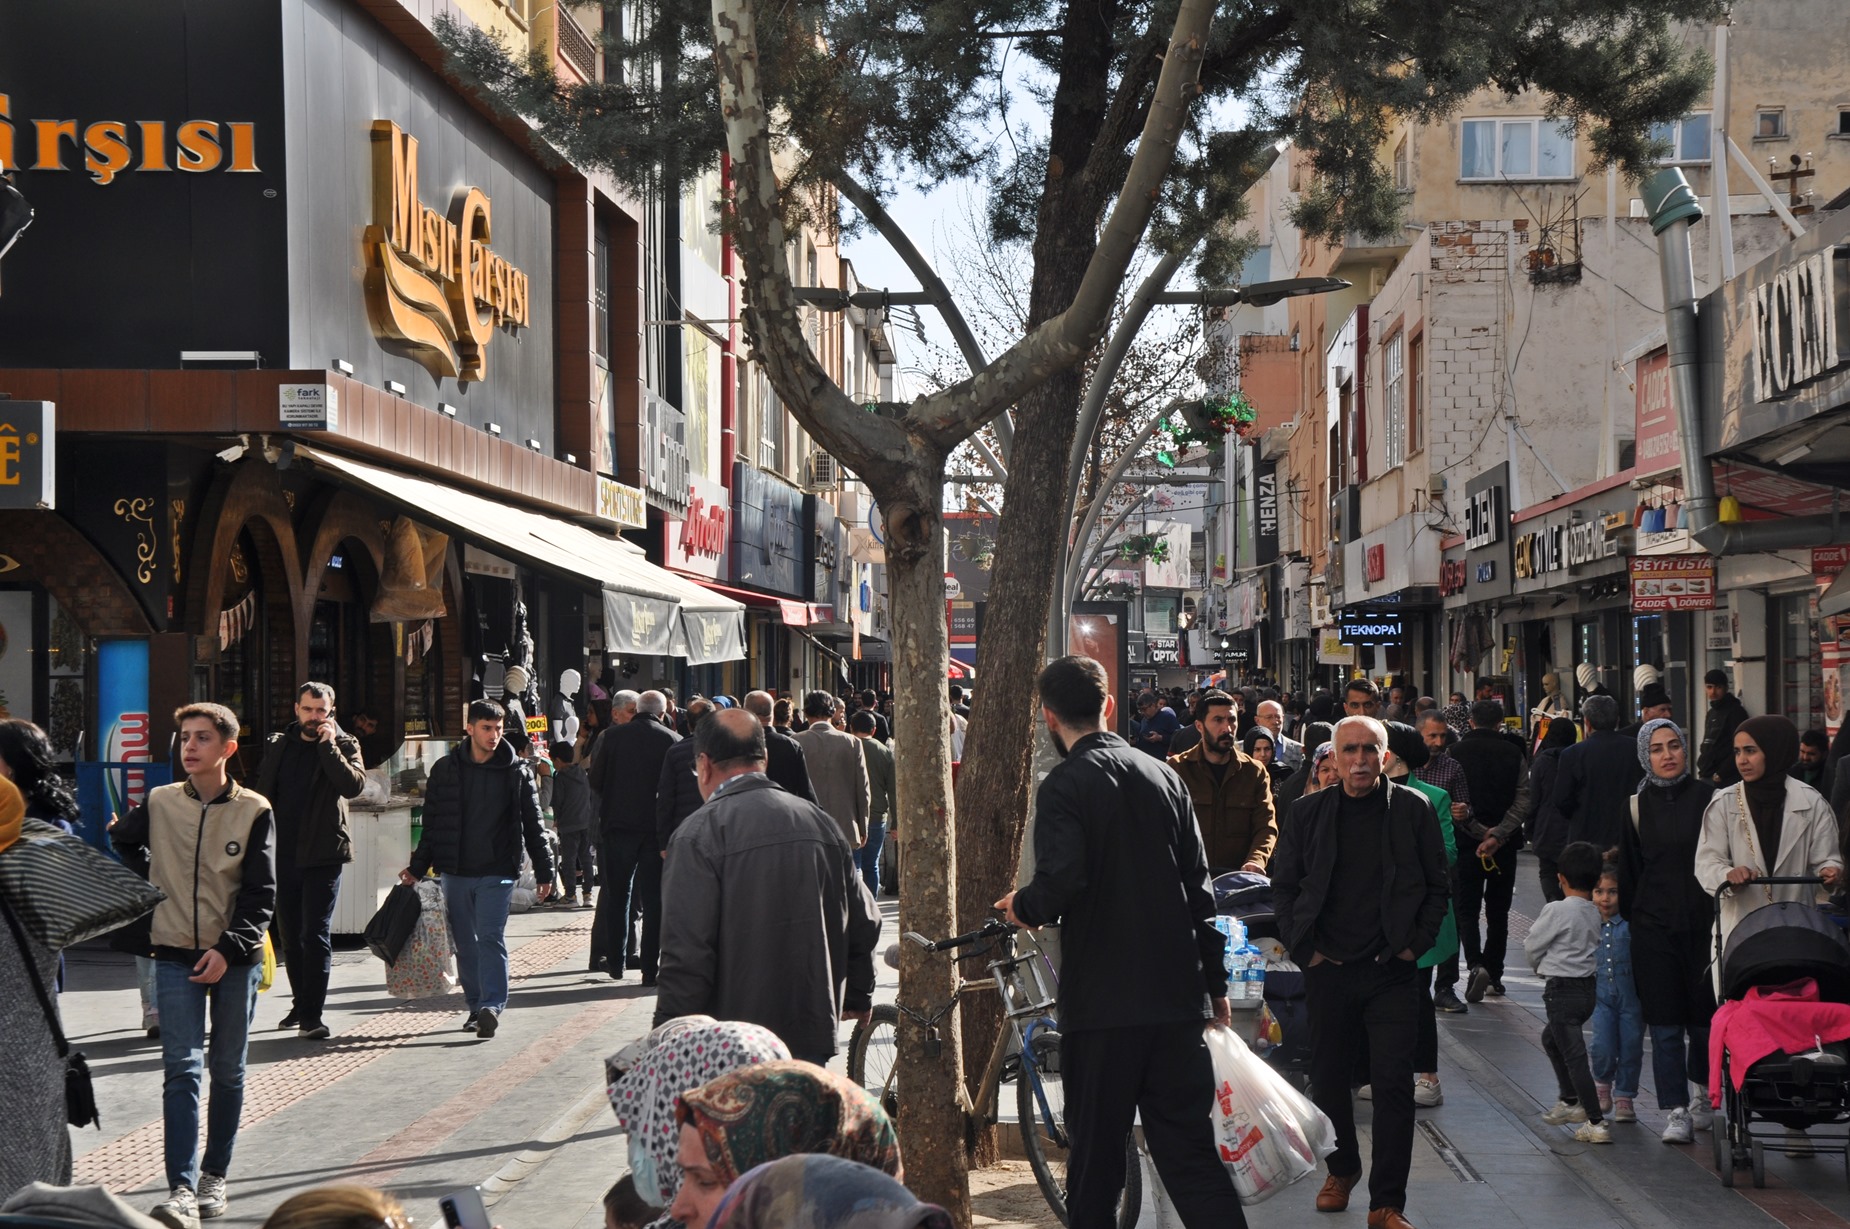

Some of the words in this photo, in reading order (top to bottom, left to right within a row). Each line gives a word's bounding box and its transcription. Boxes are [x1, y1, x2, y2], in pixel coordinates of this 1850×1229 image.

[1749, 244, 1840, 404] ECEM
[297, 388, 320, 396] fark
[1813, 552, 1840, 561] CADDE
[1676, 558, 1712, 570] USTA
[1635, 599, 1667, 608] CADDE
[1679, 598, 1712, 607] DÖNER
[1343, 625, 1397, 635] TEKNOPA
[1157, 640, 1175, 648] STAR
